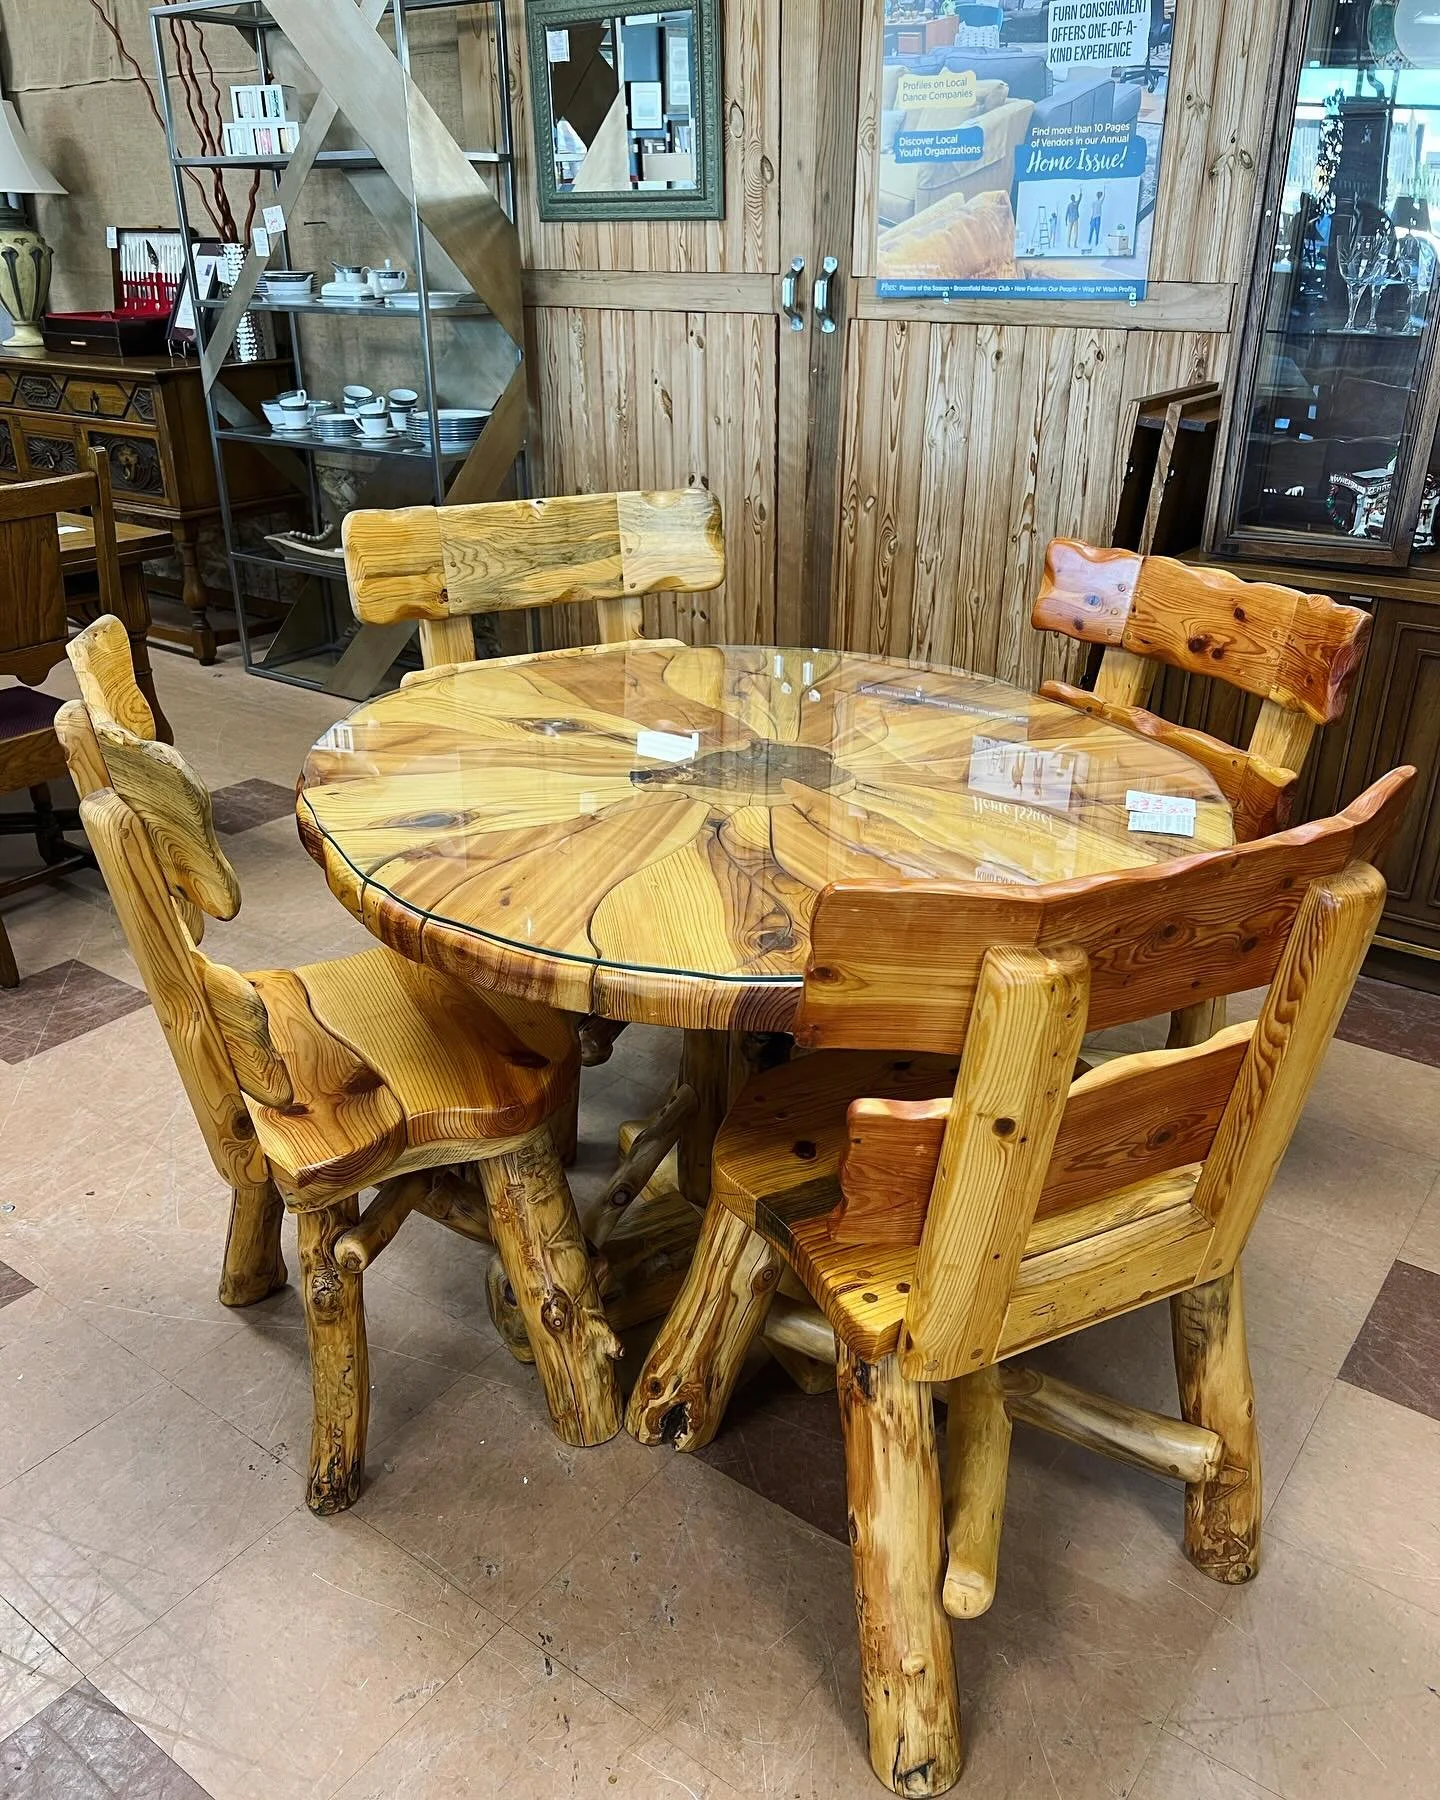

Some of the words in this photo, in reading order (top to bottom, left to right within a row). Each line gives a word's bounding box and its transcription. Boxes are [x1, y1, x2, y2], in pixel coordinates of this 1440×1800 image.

[1053, 5, 1078, 21] FURN
[1080, 0, 1146, 18] CONSIGNMENT
[1052, 24, 1086, 42] OFFERS
[1088, 20, 1137, 39] ONE-OF-A-
[1050, 46, 1072, 63] KIND
[1074, 41, 1133, 61] EXPERIENCE
[903, 80, 931, 90] Profiles
[946, 78, 967, 87] Local
[902, 93, 926, 101] Dance
[929, 90, 973, 100] Companies
[1032, 126, 1050, 136] Find
[1051, 127, 1072, 135] more
[1074, 124, 1092, 133] than
[1094, 124, 1104, 132] 10
[1105, 123, 1130, 133] Pages
[899, 136, 934, 146] Discover
[936, 134, 958, 144] Local
[1031, 138, 1040, 148] of
[1041, 137, 1073, 147] Vendors
[1075, 136, 1083, 145] in
[1085, 137, 1098, 145] our
[1100, 134, 1130, 144] Annual
[898, 147, 922, 158] Youth
[924, 145, 981, 157] Organizations
[1026, 149, 1076, 174] Home
[1076, 145, 1128, 172] Issue!
